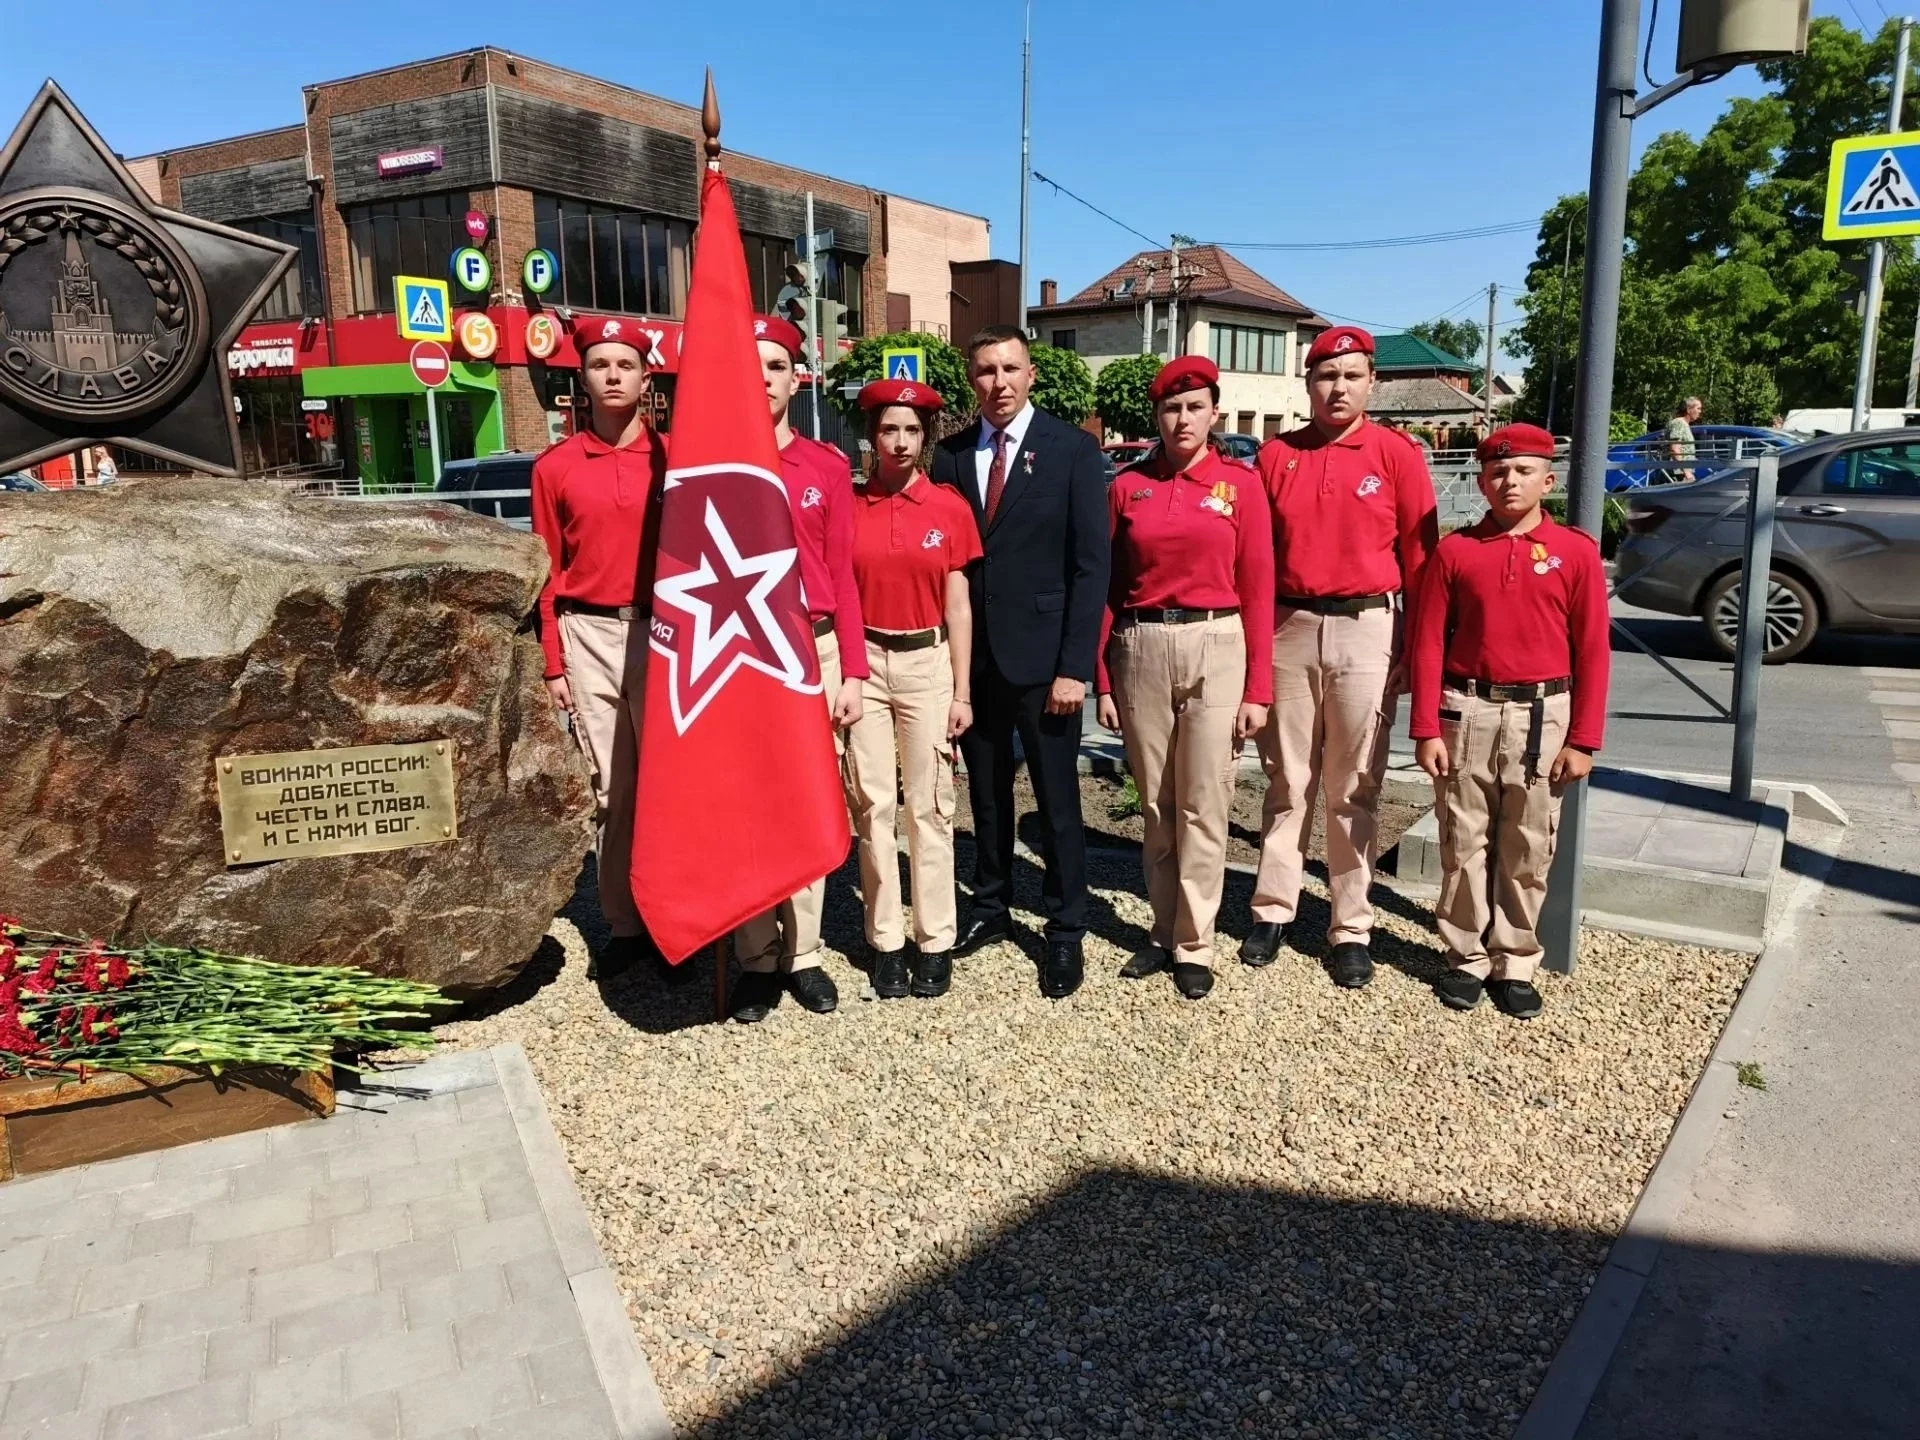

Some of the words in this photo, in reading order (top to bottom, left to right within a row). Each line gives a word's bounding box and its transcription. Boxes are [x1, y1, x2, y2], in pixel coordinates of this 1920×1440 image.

[467, 218, 485, 230] wb
[465, 257, 480, 282] F
[531, 258, 545, 283] F
[4, 346, 169, 398] СЛАВА
[241, 763, 333, 785] ВОИНАМ
[341, 755, 430, 777] РОССИИ:
[256, 805, 328, 826] ЧЕСТЬ
[336, 803, 349, 819] И
[357, 795, 431, 816] СЛАВА.
[263, 831, 277, 847] И
[285, 828, 300, 845] С
[308, 821, 368, 842] НАМИ
[375, 816, 420, 835] БОГ.
